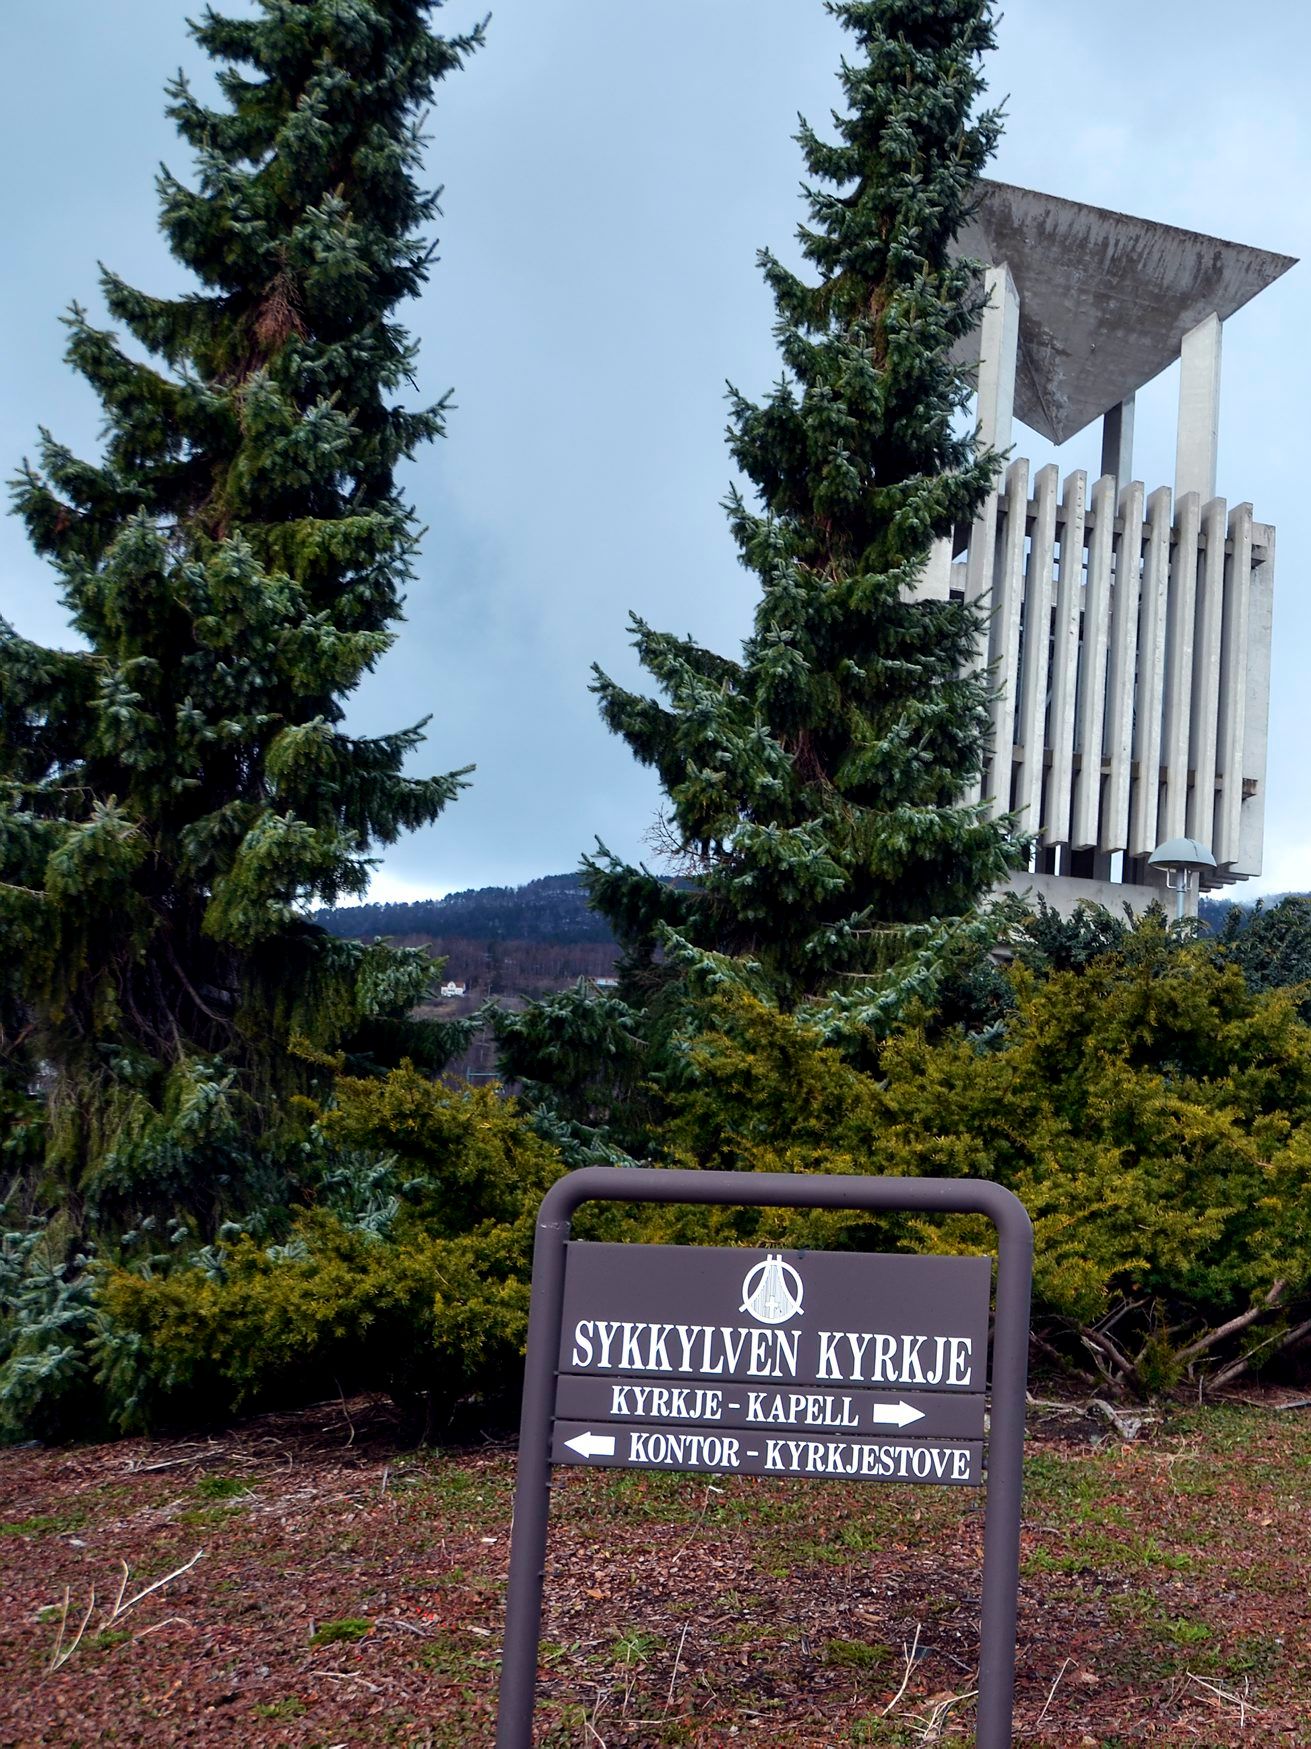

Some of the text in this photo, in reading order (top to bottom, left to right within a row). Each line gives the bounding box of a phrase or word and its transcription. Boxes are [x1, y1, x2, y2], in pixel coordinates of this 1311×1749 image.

[572, 1319, 972, 1386] SYKKYLVEN KYRKJE
[610, 1385, 723, 1420] KYRKJE
[745, 1392, 859, 1427] KAPELL
[628, 1432, 741, 1467] KONTOR
[764, 1439, 971, 1480] KYRKJESTOVE
